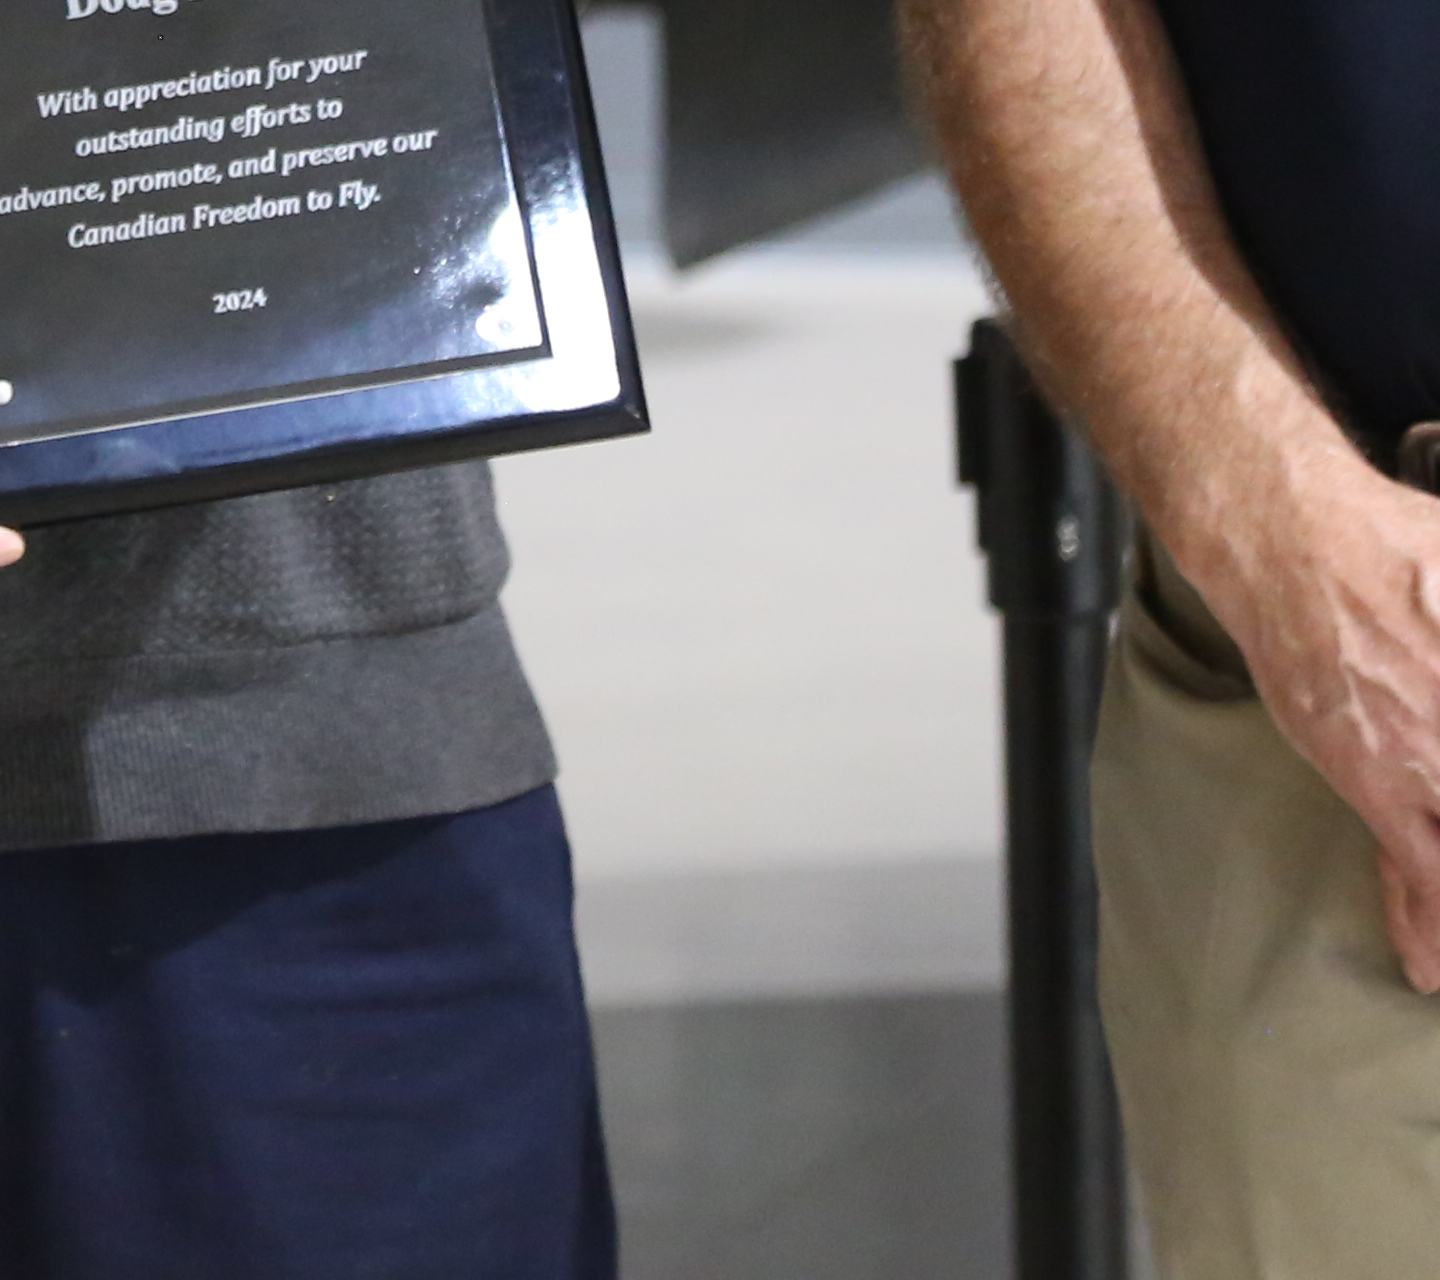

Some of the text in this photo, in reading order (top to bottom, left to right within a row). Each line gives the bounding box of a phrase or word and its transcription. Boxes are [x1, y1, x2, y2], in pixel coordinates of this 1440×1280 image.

[37, 50, 368, 118] With appreciation for your
[75, 98, 343, 156] outstanding efforts to
[111, 163, 223, 203] promote,
[228, 148, 276, 178] and
[281, 137, 388, 176] preserve
[393, 129, 438, 153] our
[68, 179, 381, 247] Canadian Freedom to Fly.
[212, 287, 268, 313] 2024
